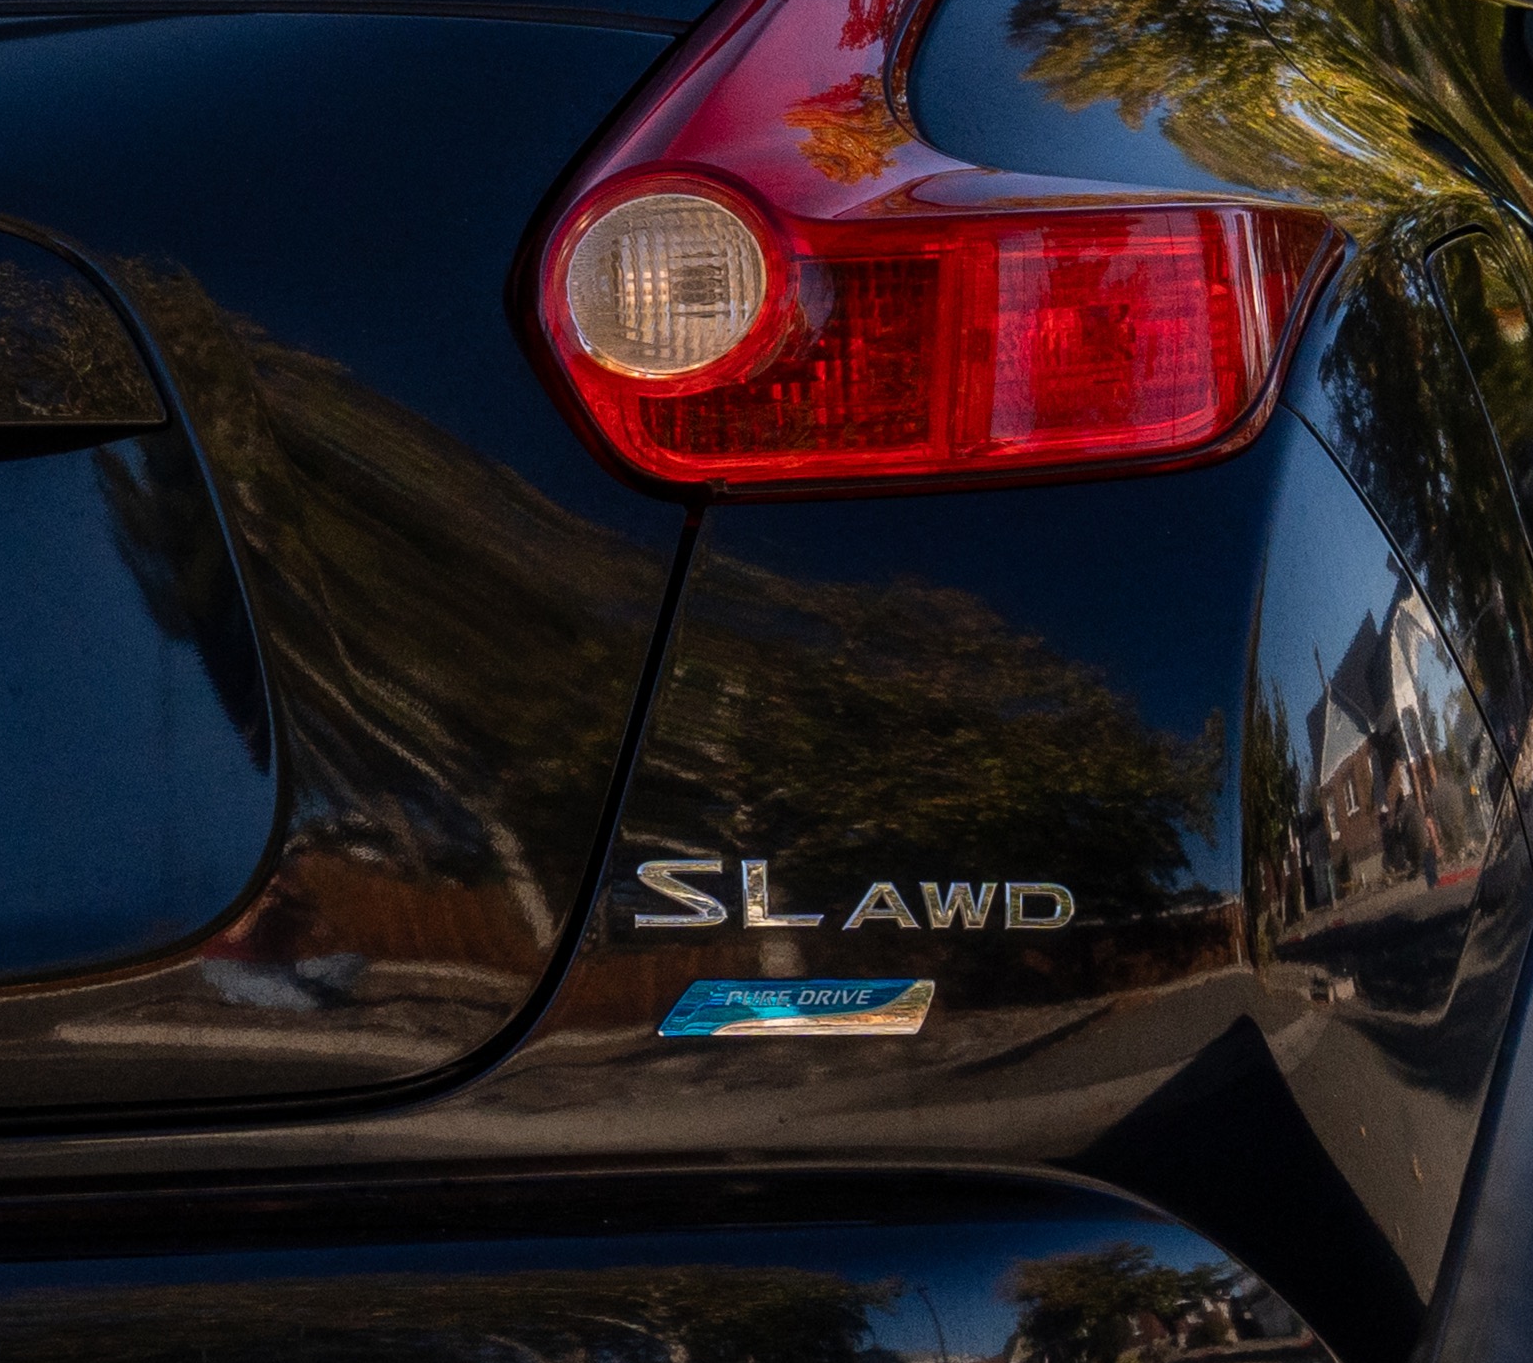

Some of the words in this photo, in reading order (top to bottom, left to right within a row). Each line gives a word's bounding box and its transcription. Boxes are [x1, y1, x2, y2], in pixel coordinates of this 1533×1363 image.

[634, 858, 825, 930] SL
[842, 880, 1076, 932] AWD
[723, 989, 792, 1008] PURE
[796, 987, 874, 1007] DRIVE
